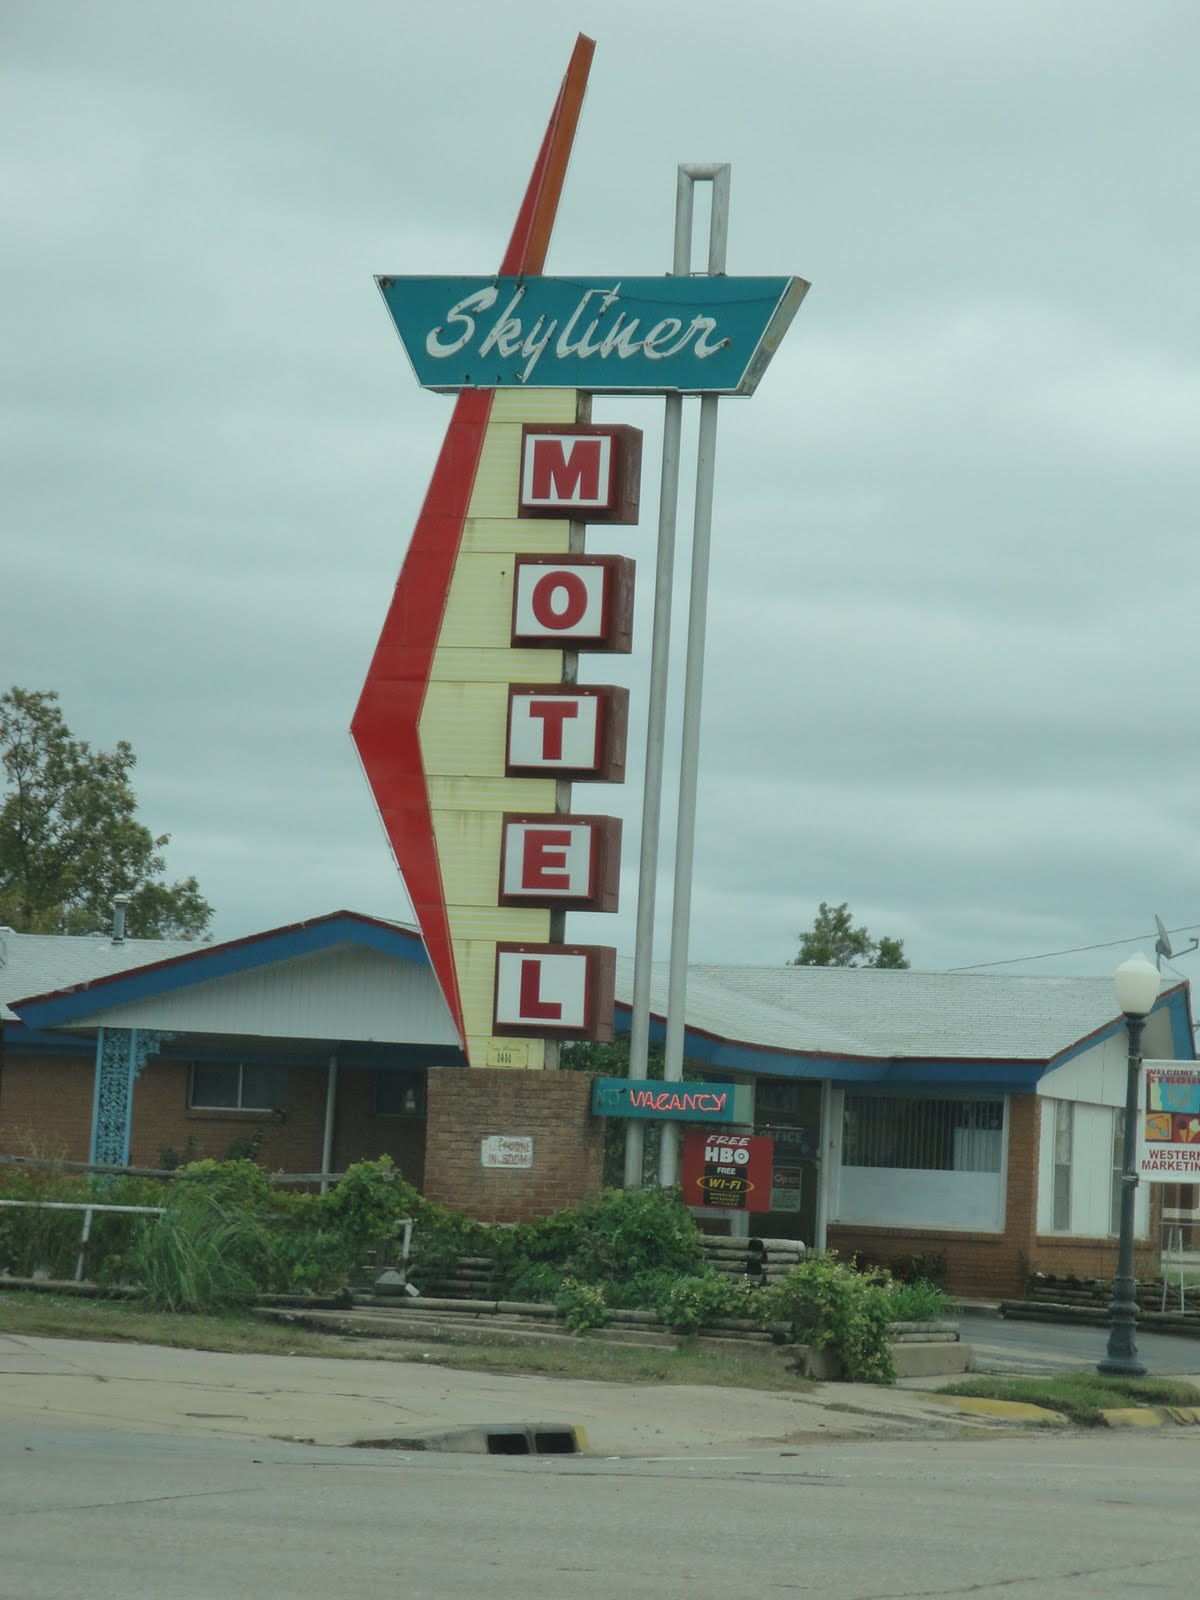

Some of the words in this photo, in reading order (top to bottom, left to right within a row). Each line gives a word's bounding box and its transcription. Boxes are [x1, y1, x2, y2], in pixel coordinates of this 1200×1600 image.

[425, 282, 732, 384] Skyliner
[519, 439, 602, 1020] MOTEL
[629, 1089, 727, 1112] VACANCY
[706, 1134, 750, 1146] FREE
[704, 1146, 750, 1165] HBO
[717, 1167, 736, 1175] FREE
[709, 1178, 742, 1190] WI-FI
